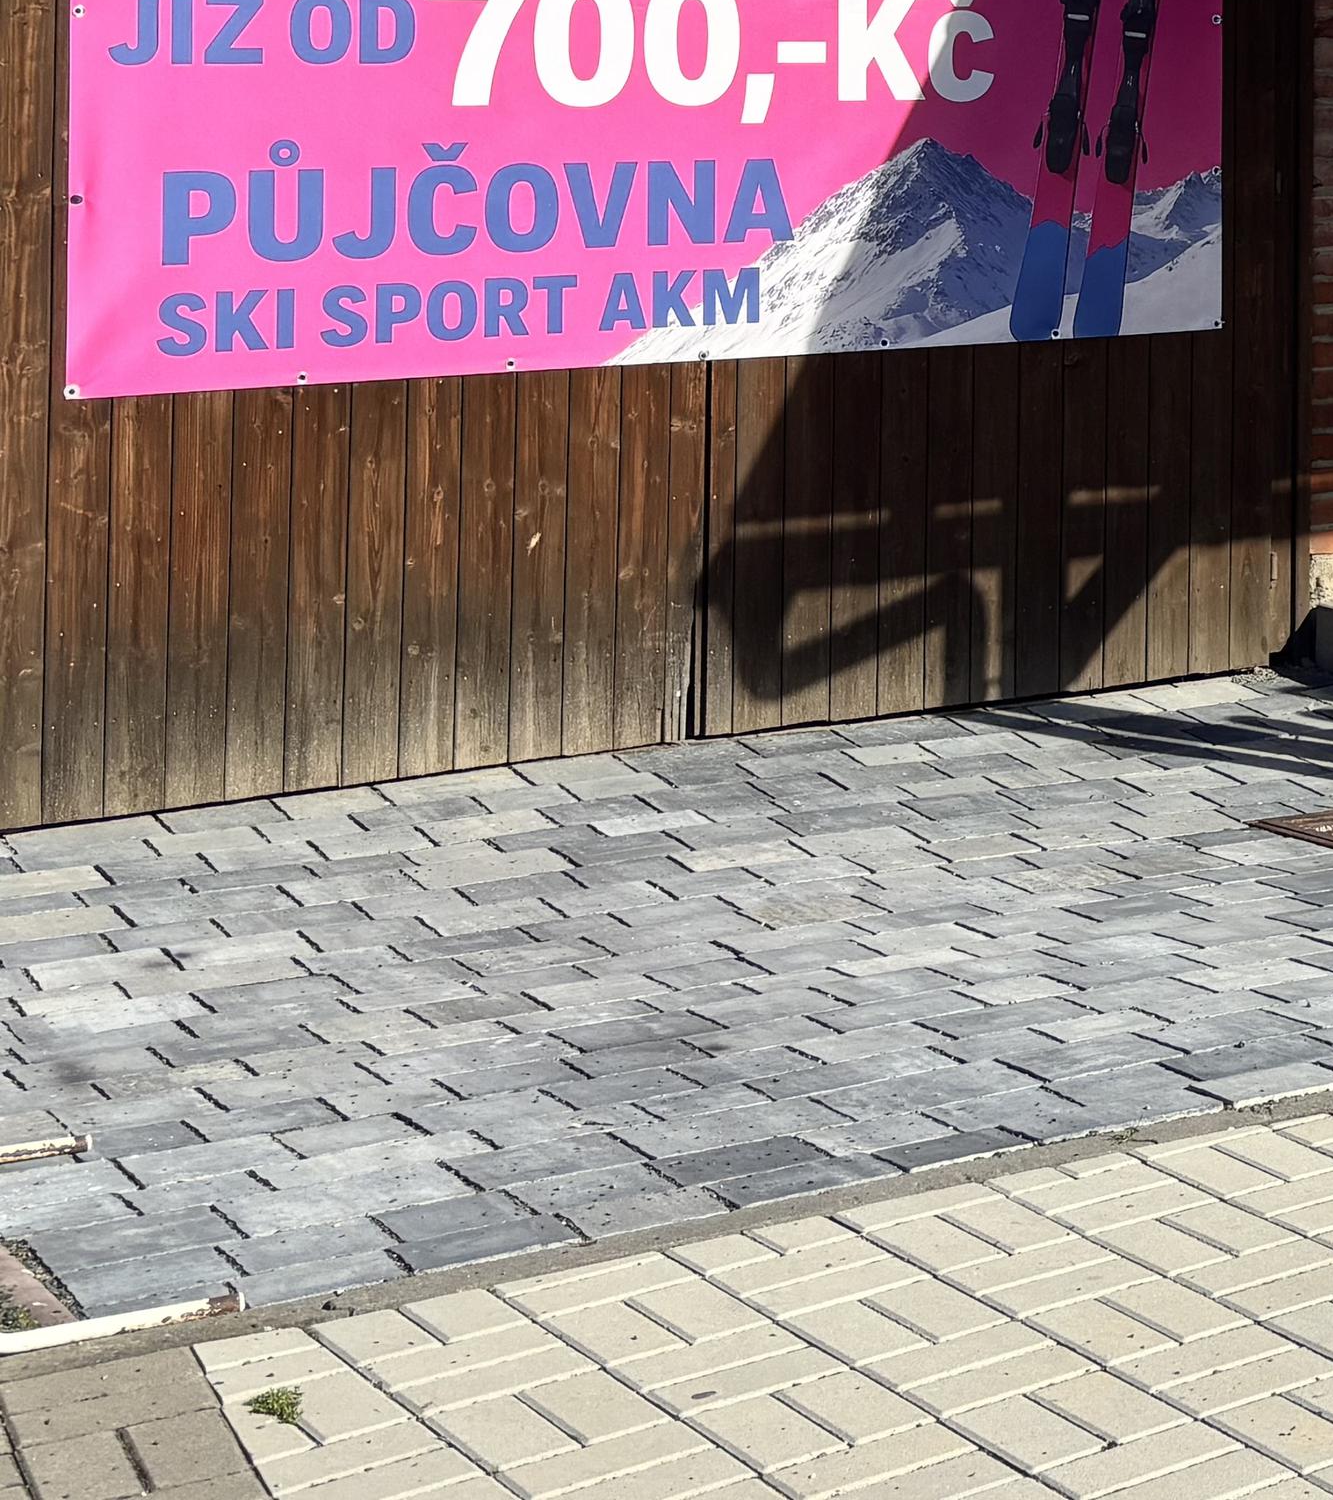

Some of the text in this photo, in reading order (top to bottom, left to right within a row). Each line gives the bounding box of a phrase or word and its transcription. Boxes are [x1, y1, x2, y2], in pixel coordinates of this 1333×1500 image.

[161, 138, 793, 267] PŮJČOVNA
[157, 267, 761, 358] SKI SPORT AKM
